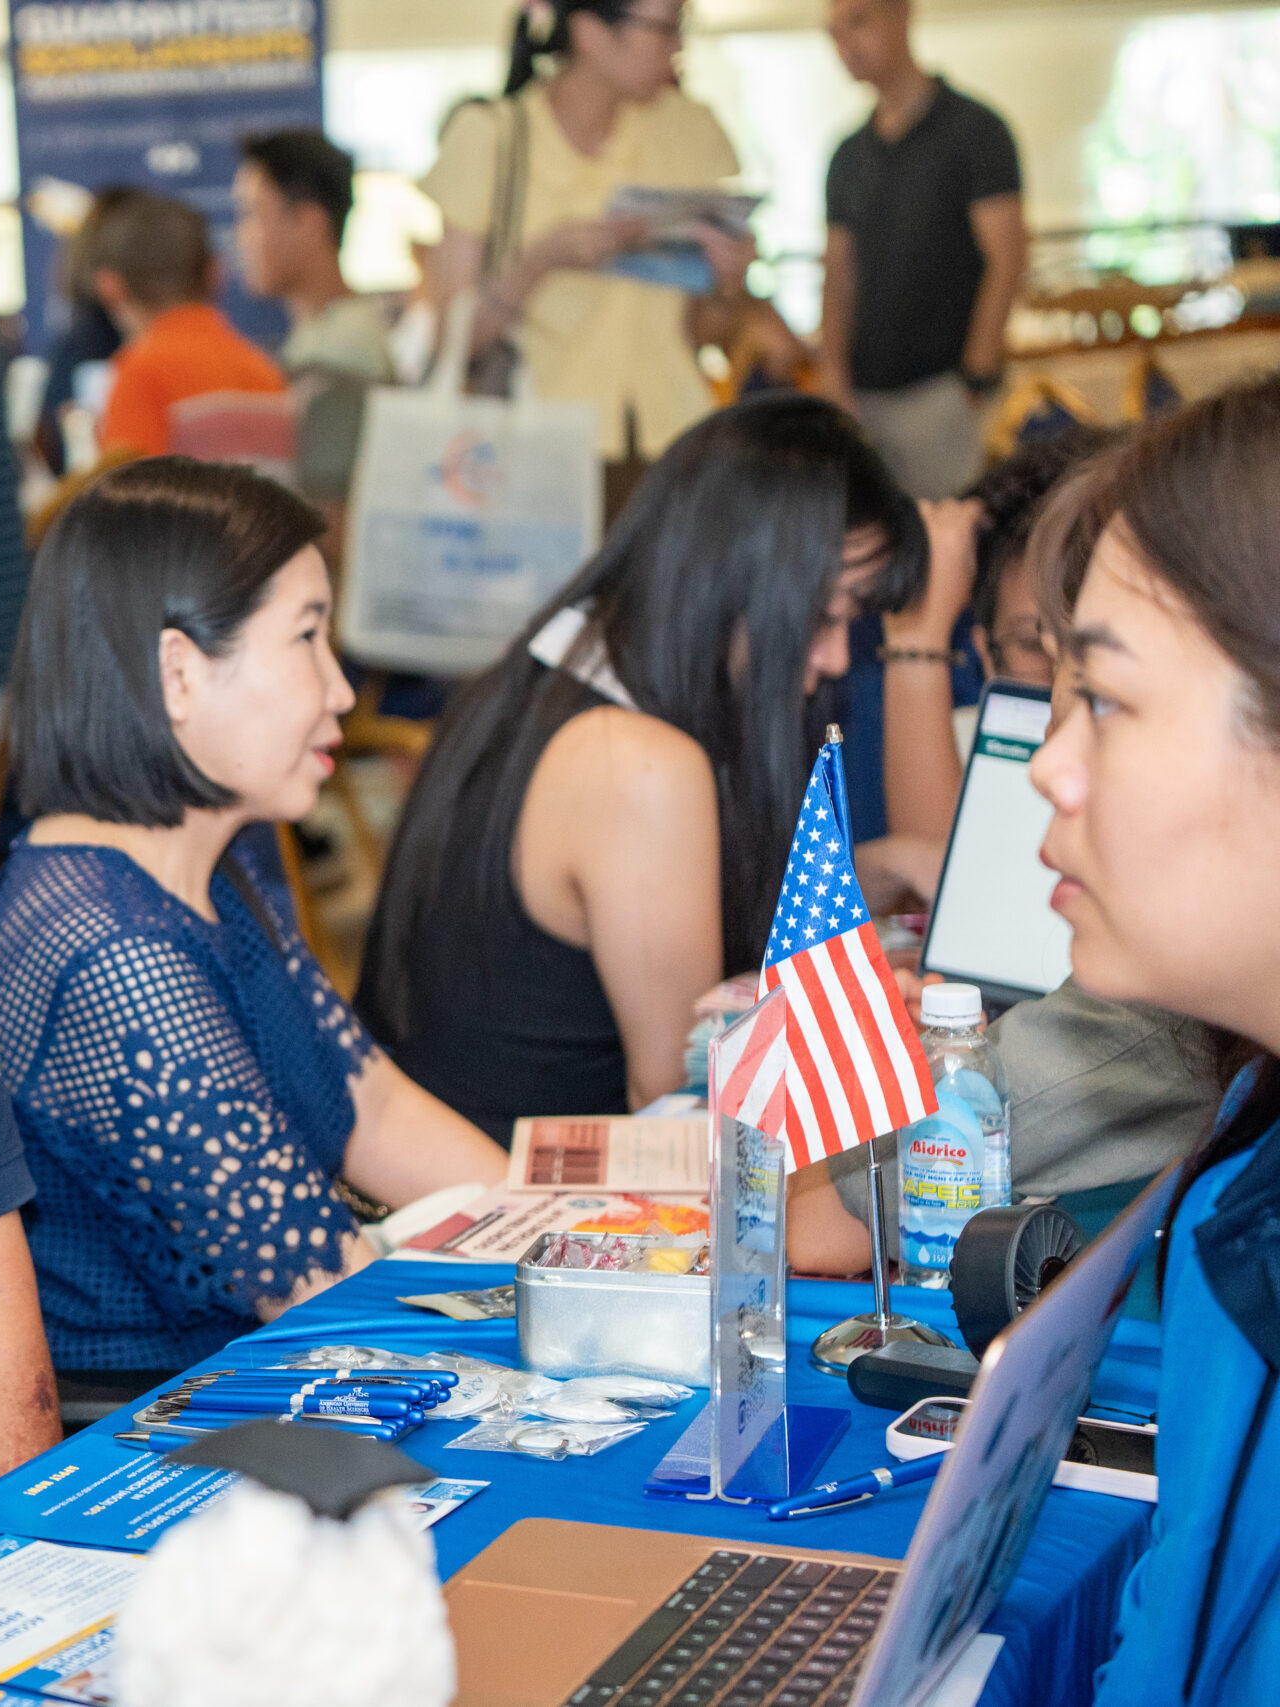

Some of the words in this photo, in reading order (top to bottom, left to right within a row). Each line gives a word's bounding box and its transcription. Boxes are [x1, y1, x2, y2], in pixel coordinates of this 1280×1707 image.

[910, 1139, 966, 1158] Bidrico
[904, 1178, 980, 1201] APEC
[48, 1464, 81, 1481] APPLY
